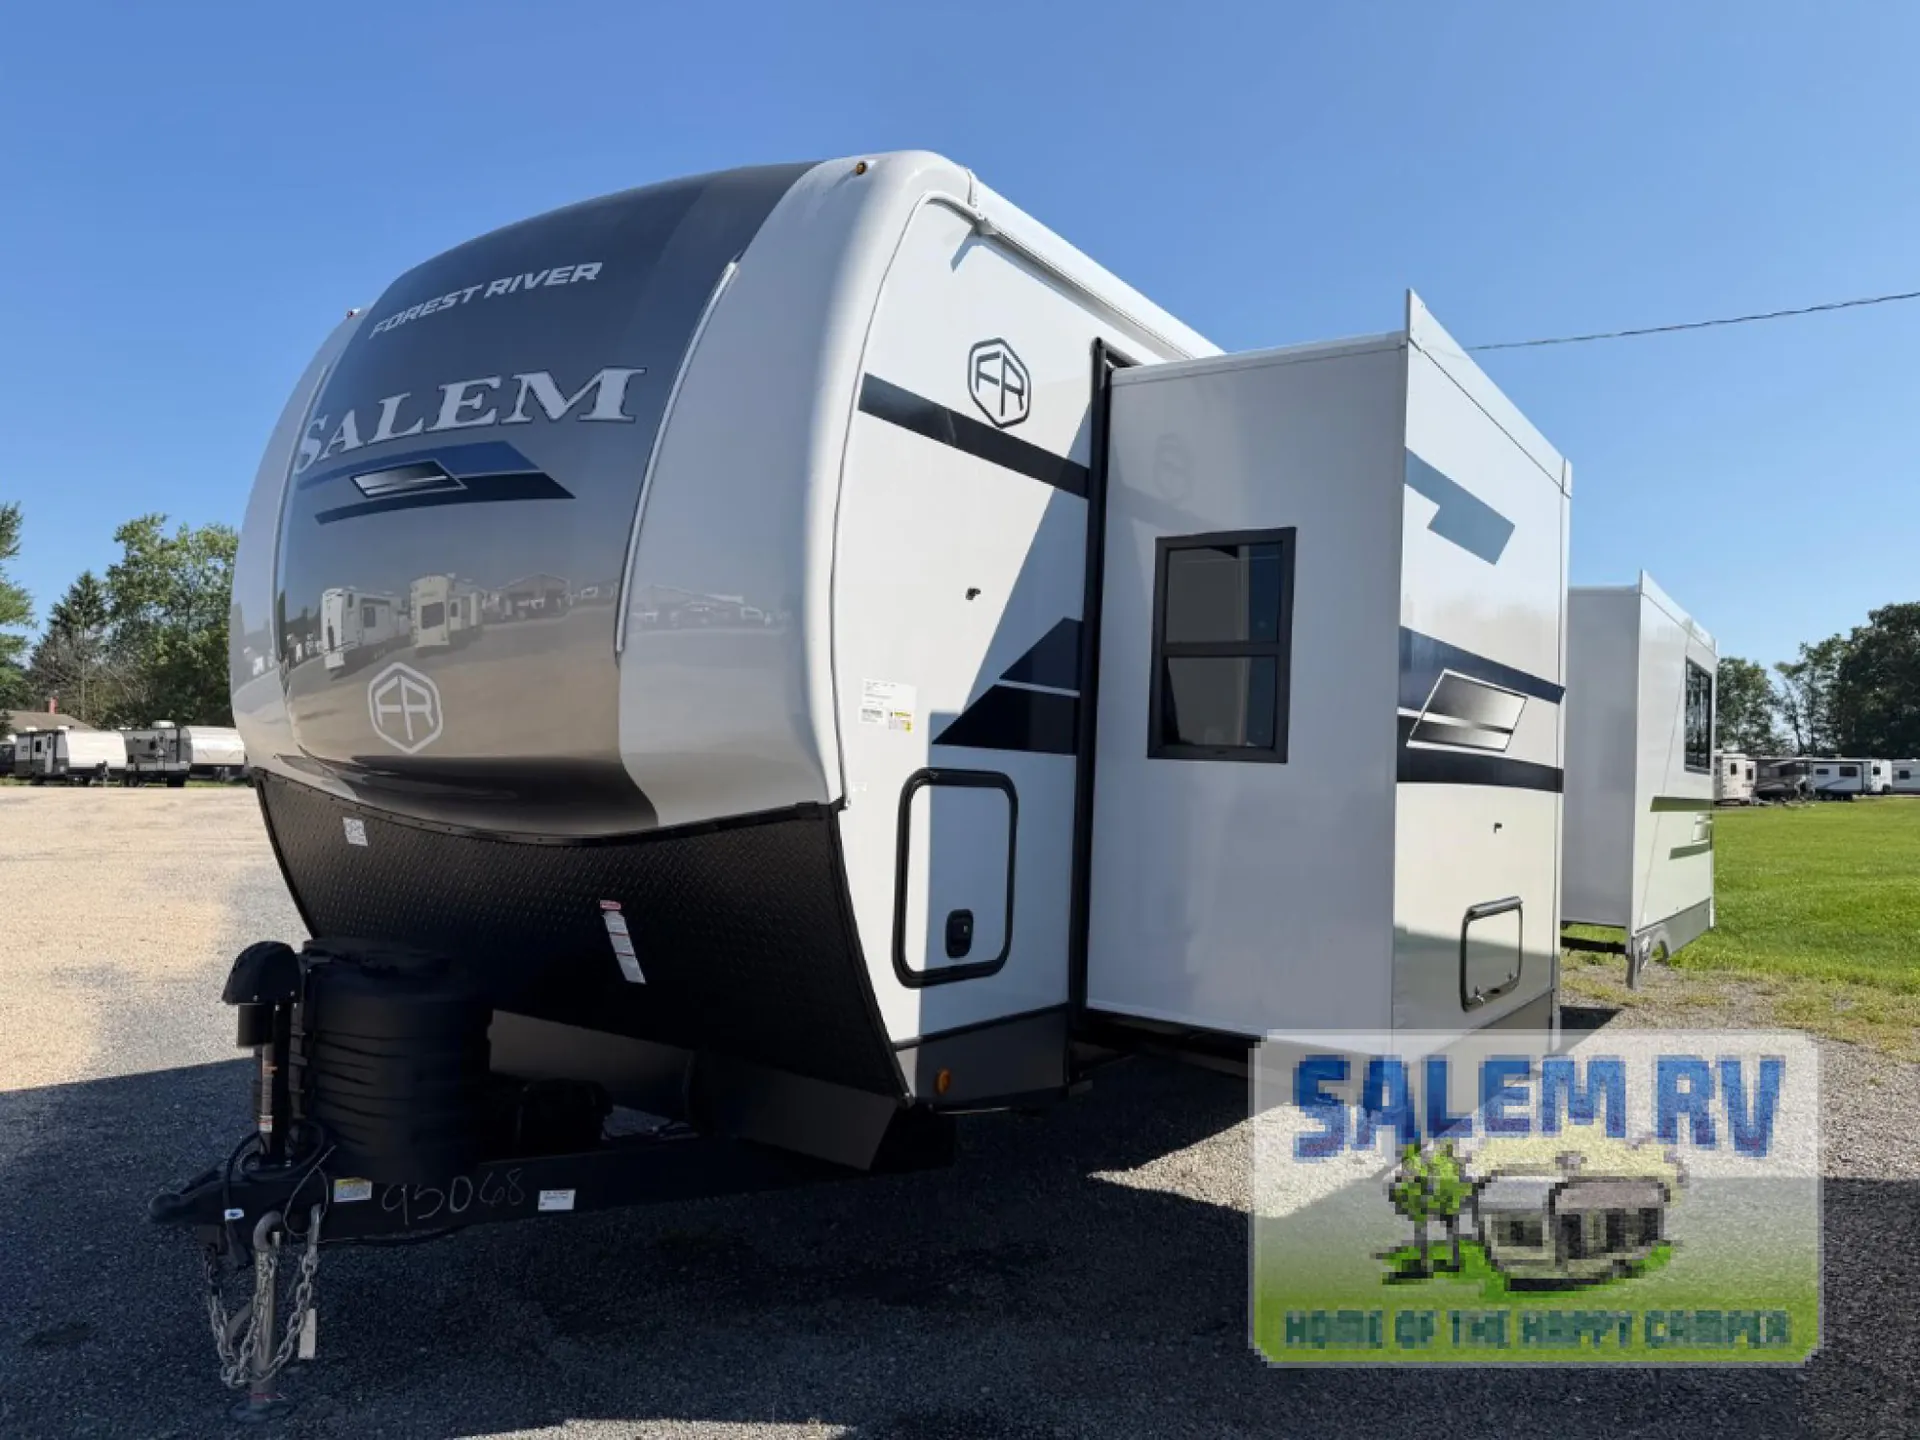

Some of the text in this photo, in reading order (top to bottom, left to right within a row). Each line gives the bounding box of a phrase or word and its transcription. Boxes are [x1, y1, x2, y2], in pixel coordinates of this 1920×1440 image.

[368, 261, 603, 340] FOREST RIVER
[295, 365, 648, 476] SALEM
[381, 1167, 527, 1226] 95068
